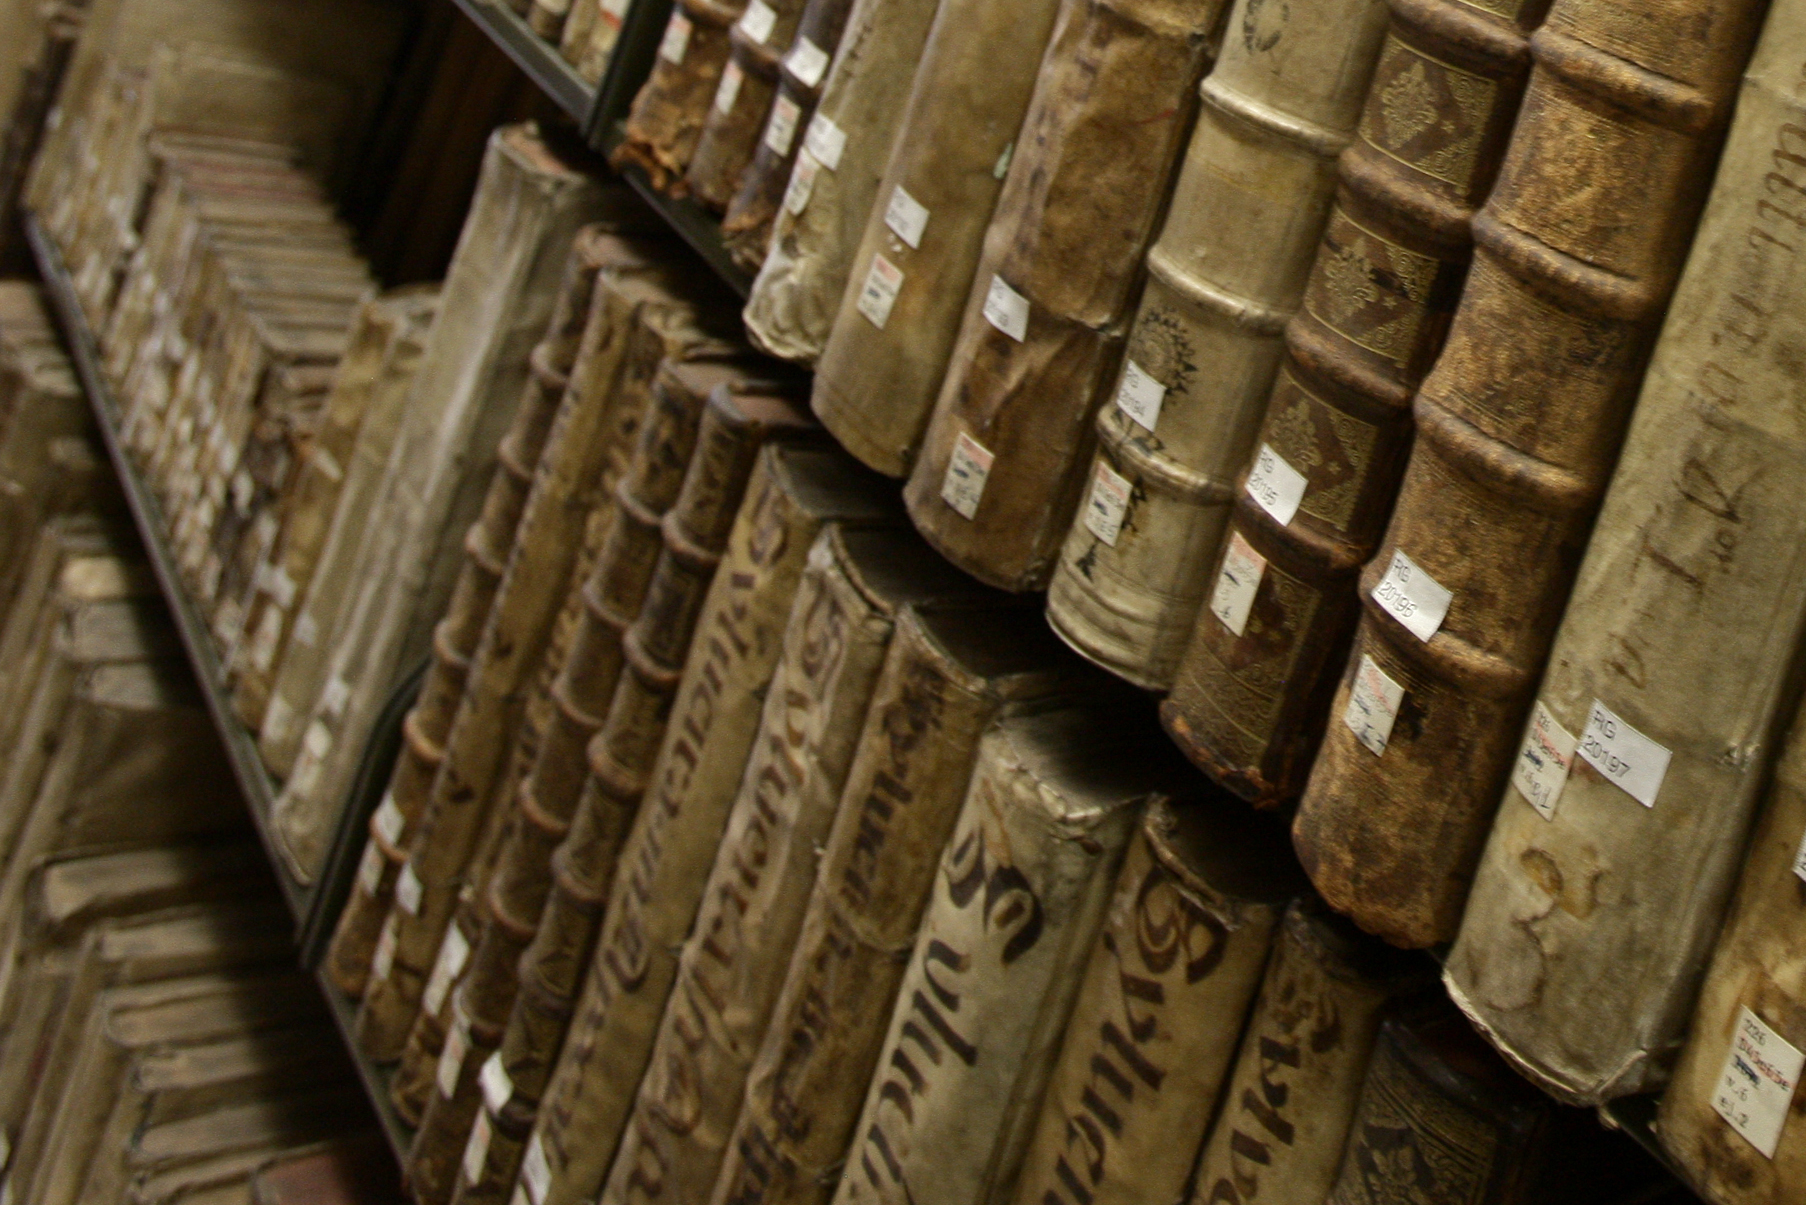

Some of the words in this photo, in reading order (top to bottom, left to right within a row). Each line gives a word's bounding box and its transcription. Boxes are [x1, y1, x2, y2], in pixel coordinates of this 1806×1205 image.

[1393, 558, 1412, 584] RG
[1377, 579, 1419, 618] 20196
[1594, 710, 1618, 740] RG
[1584, 734, 1631, 778] 20197
